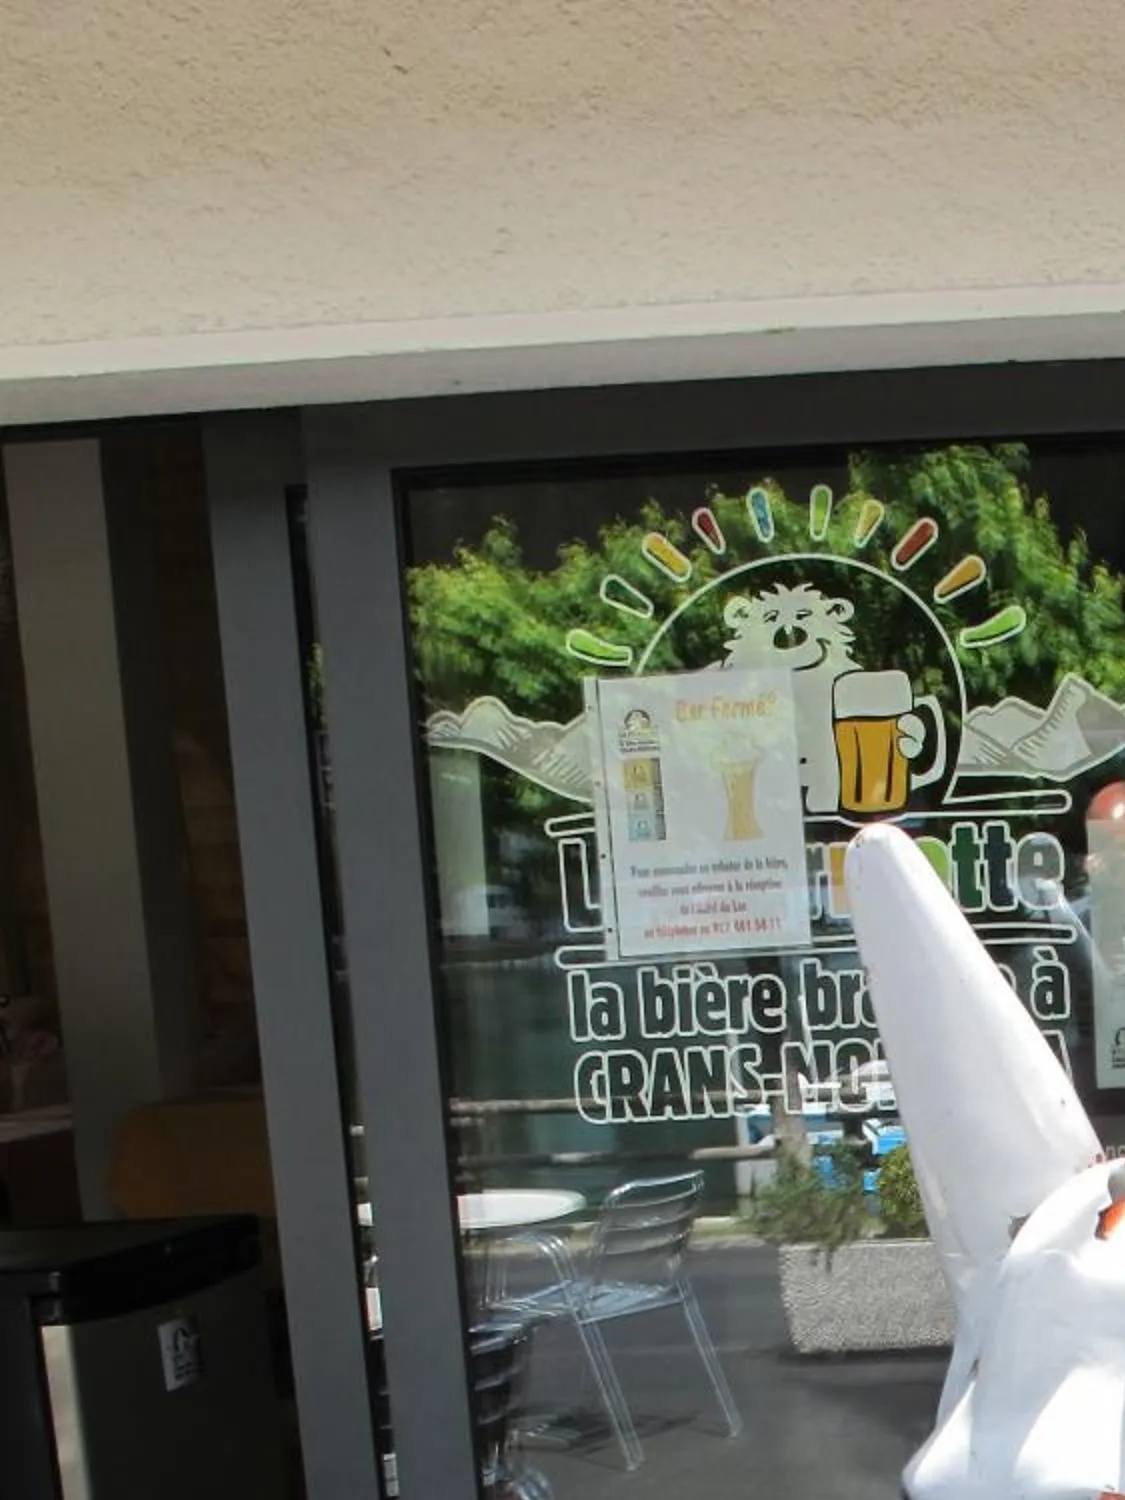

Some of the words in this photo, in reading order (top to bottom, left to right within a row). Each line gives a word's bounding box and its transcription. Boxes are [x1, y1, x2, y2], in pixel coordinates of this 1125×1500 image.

[567, 969, 626, 1042] la
[637, 962, 787, 1038] bière
[1031, 946, 1071, 1020] à
